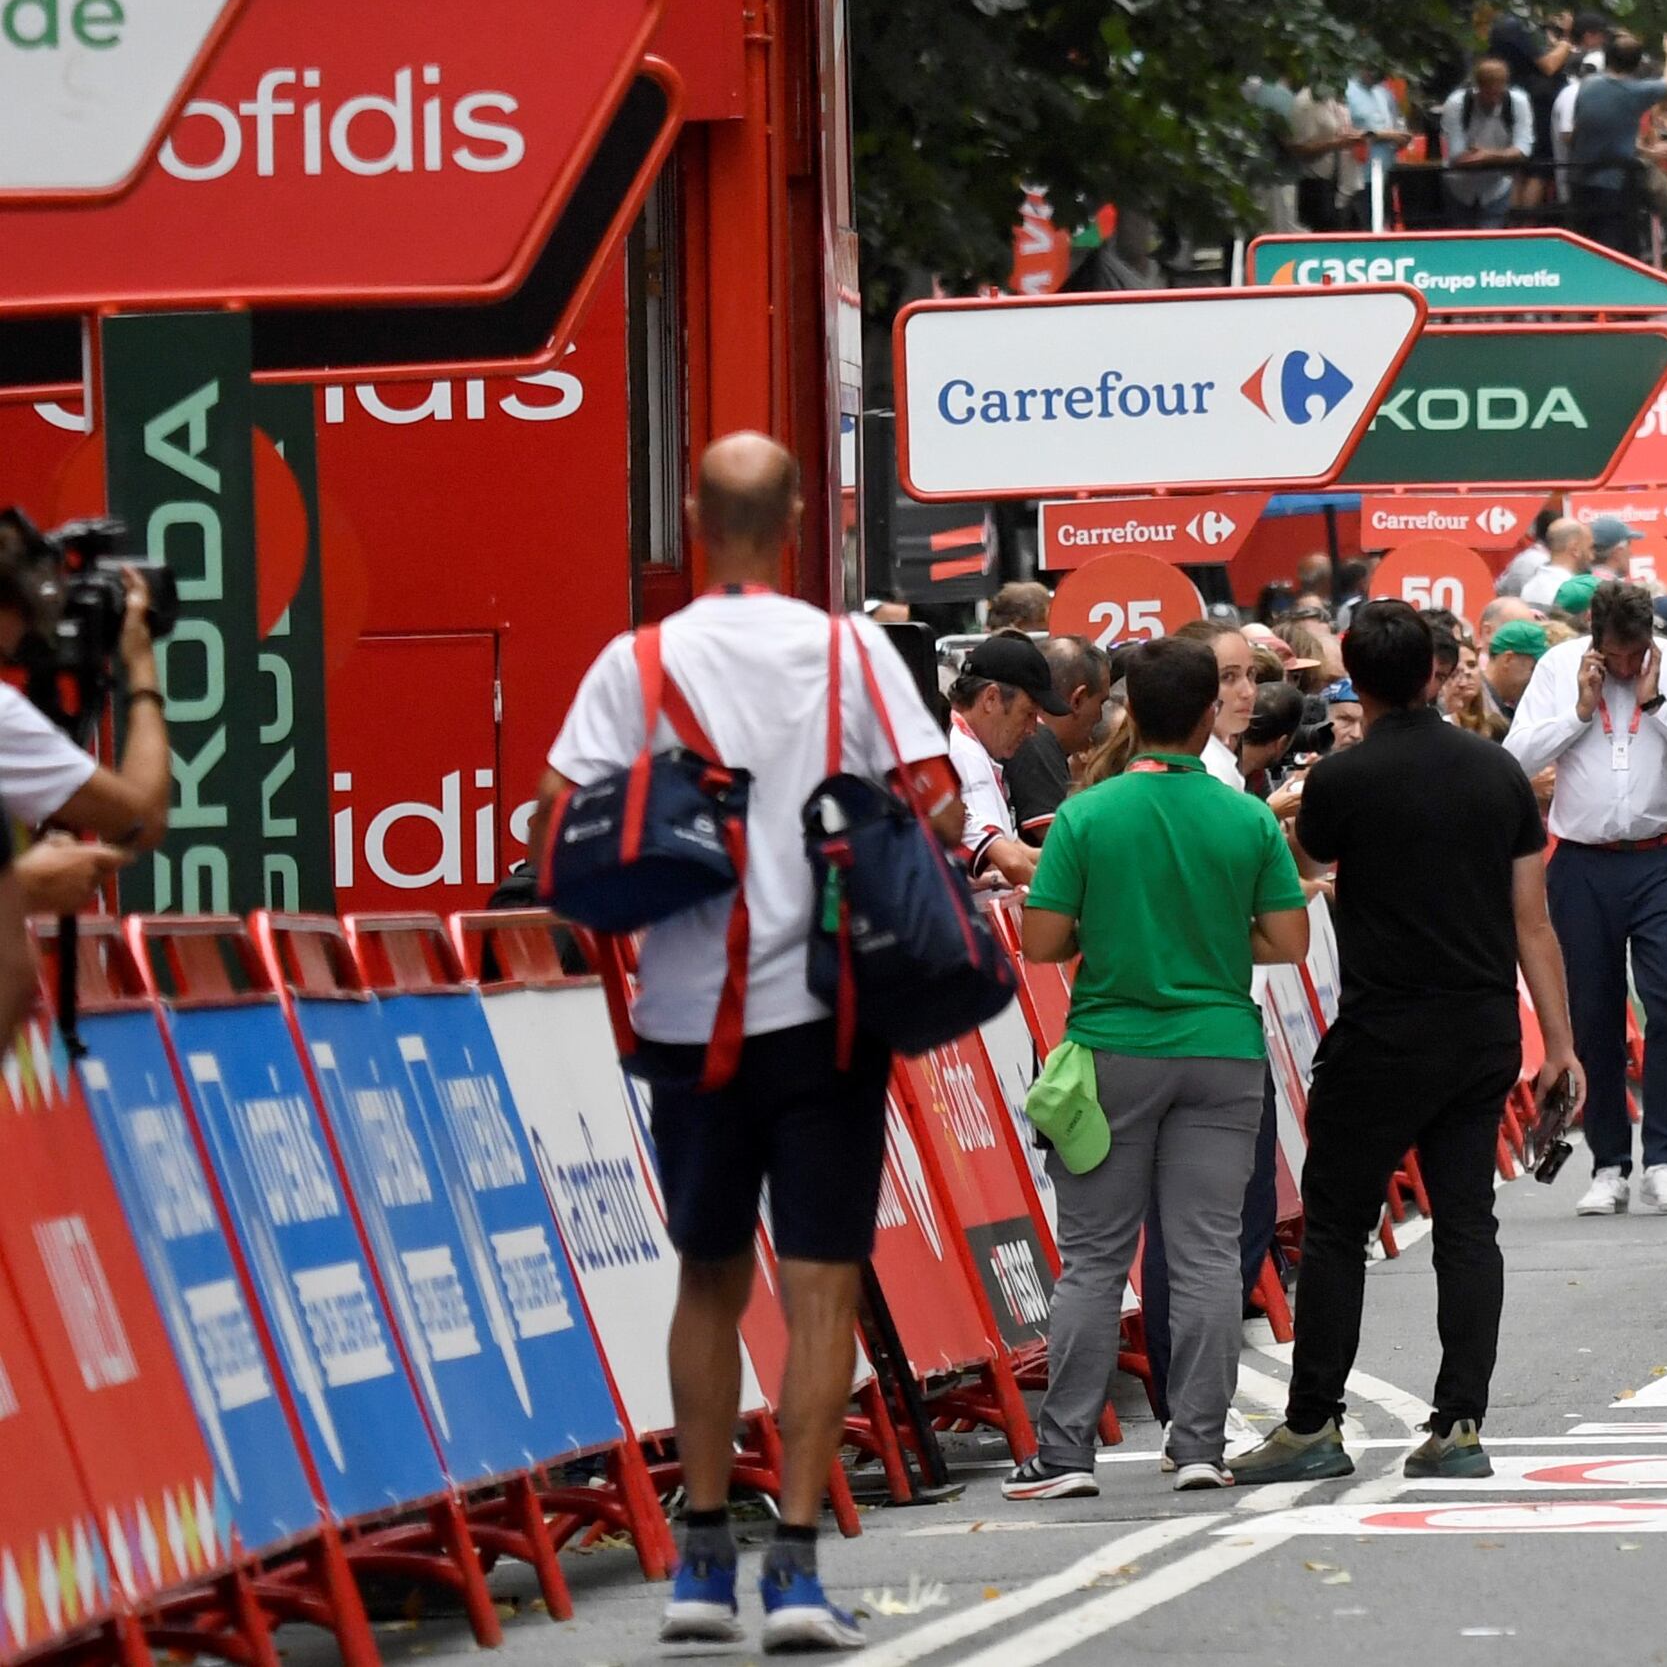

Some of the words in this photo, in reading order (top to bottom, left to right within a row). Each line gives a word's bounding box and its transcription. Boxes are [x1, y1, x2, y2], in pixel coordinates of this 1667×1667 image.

[157, 64, 525, 181] ofidis
[1297, 256, 1415, 285] caser
[1413, 270, 1477, 294] Grupo
[1480, 269, 1560, 289] Helvetia
[937, 370, 1215, 426] Carrefour
[1057, 516, 1177, 547] Carrefour
[1370, 509, 1470, 533] Carrefour
[1628, 556, 1659, 586] 5
[1087, 599, 1166, 650] 25
[530, 1110, 660, 1276] Carrefour
